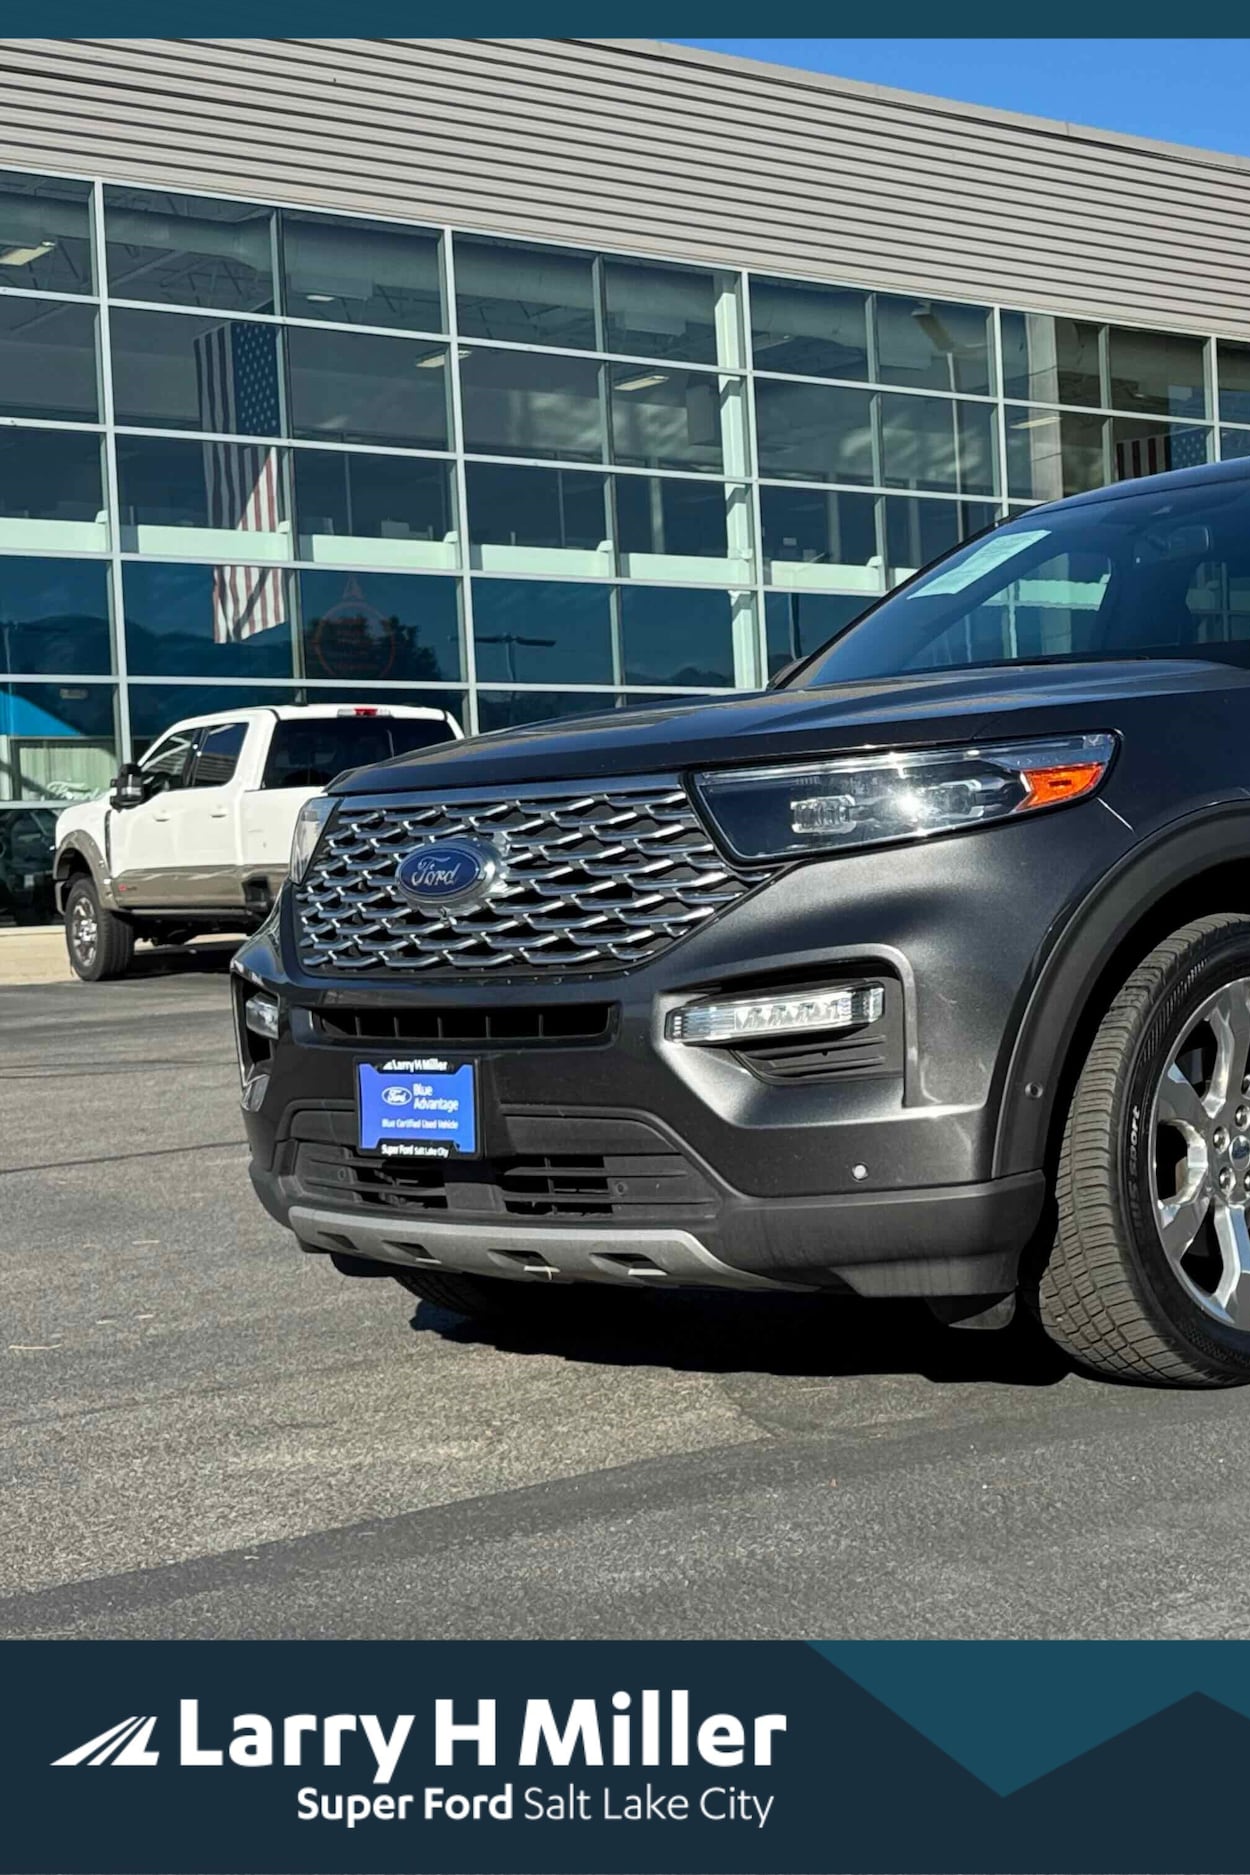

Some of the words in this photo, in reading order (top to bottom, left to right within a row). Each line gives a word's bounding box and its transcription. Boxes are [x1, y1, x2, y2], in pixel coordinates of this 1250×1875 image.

[411, 856, 462, 886] Ford
[413, 1083, 433, 1096] Blue
[413, 1097, 459, 1113] Advantage
